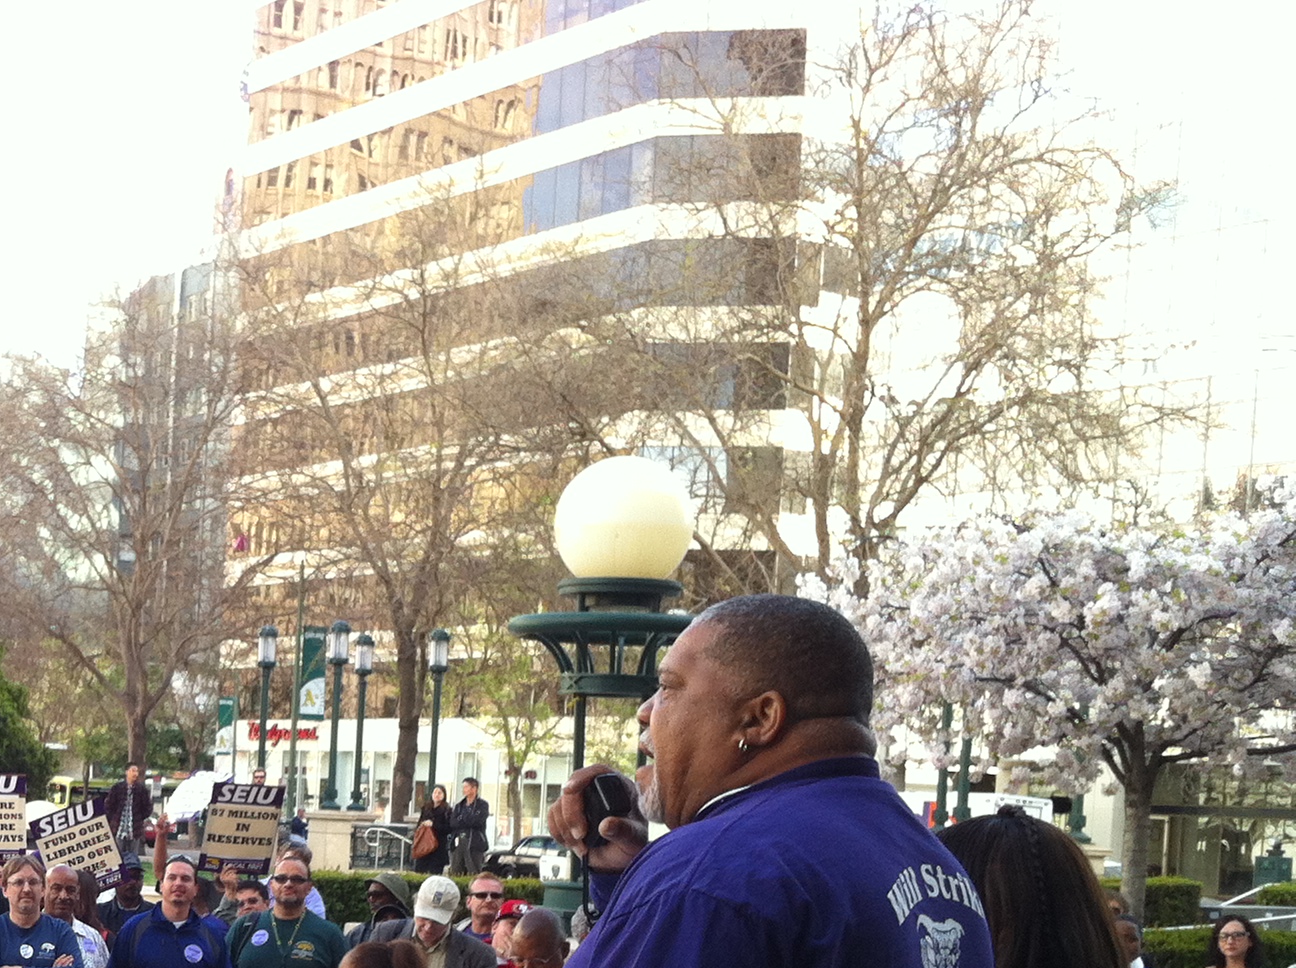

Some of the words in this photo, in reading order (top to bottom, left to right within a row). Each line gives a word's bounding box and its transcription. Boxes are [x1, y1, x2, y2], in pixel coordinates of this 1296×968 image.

[217, 784, 278, 805] SEIU
[39, 799, 94, 838] SEIU
[227, 809, 279, 821] MILLION
[44, 832, 76, 850] FUND
[78, 821, 104, 836] OUR
[235, 823, 251, 832] IN
[45, 832, 111, 862] LIBRARIES
[206, 833, 273, 846] RESERVES
[87, 844, 113, 859] OUR
[887, 866, 923, 927] Will
[920, 863, 985, 920] Strik
